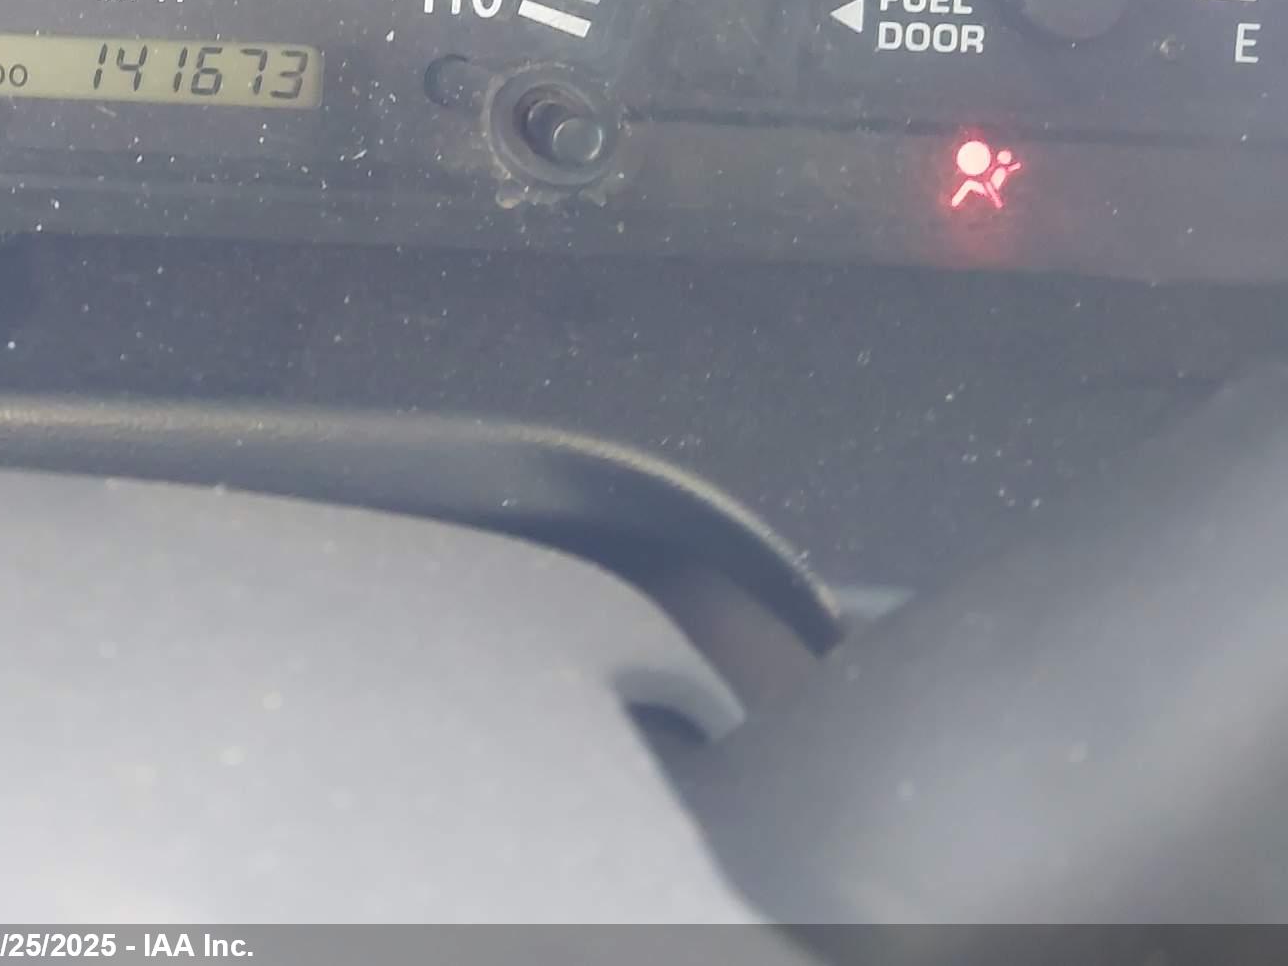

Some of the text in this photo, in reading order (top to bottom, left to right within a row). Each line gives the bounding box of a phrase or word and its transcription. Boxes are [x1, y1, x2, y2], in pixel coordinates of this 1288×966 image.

[878, 21, 985, 54] DOOR
[1235, 22, 1261, 63] E
[93, 43, 309, 100] 141673
